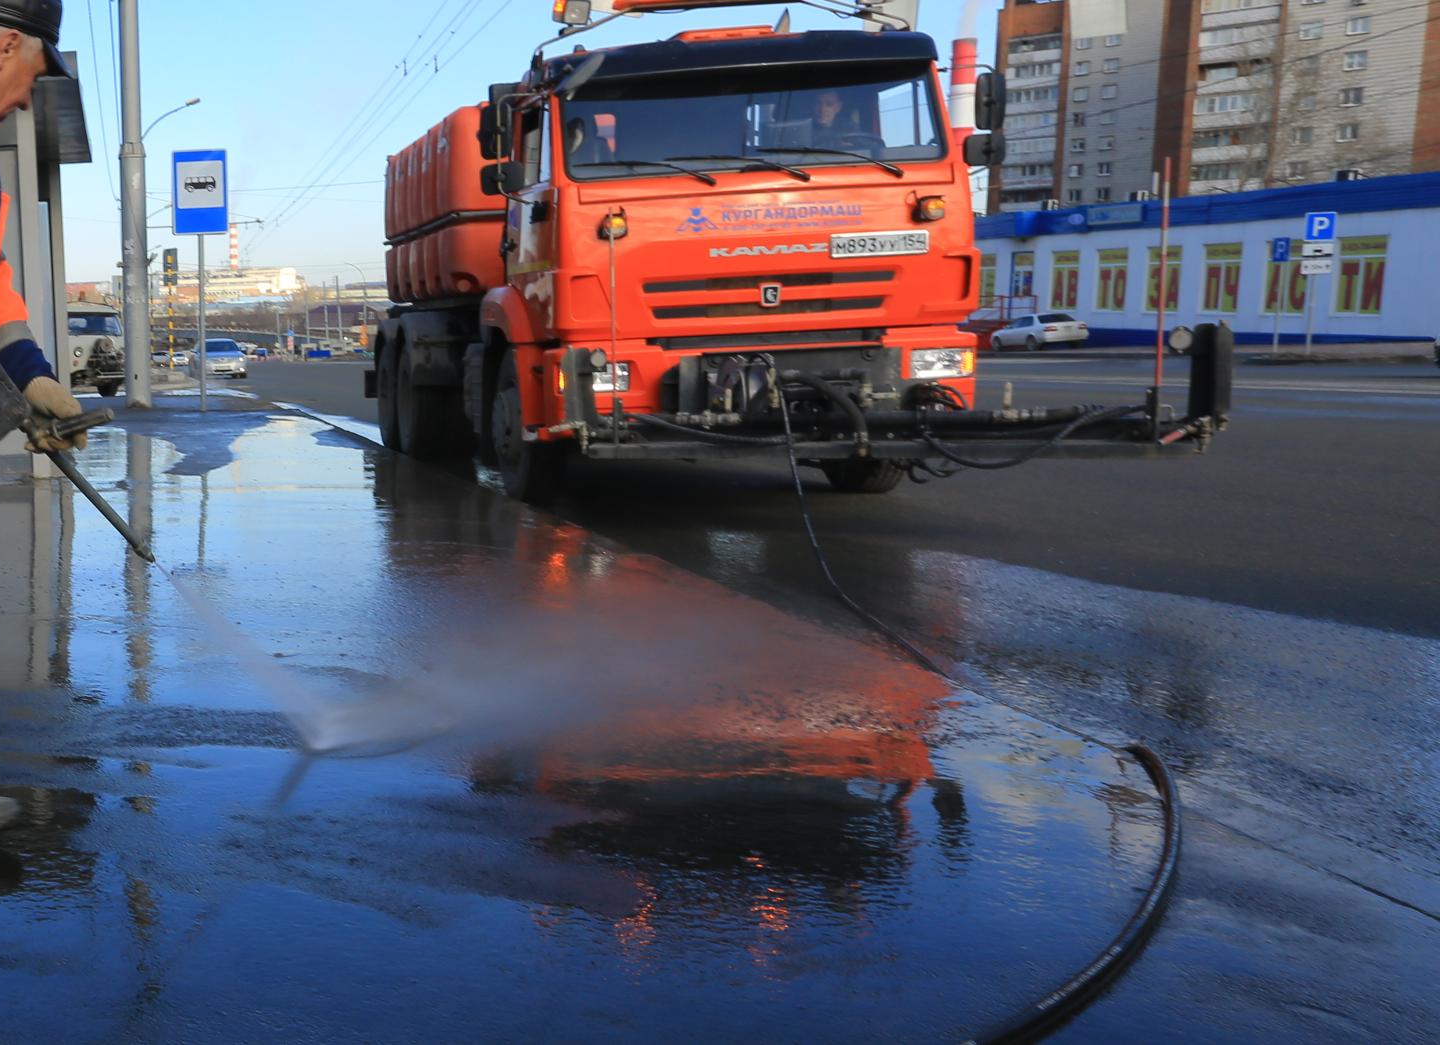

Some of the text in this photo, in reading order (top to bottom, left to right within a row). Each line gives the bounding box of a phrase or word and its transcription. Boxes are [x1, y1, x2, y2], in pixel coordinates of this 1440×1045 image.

[722, 203, 862, 222] КУРГАНДОРМАШ
[1311, 216, 1330, 237] P
[710, 242, 828, 257] KAMAZ
